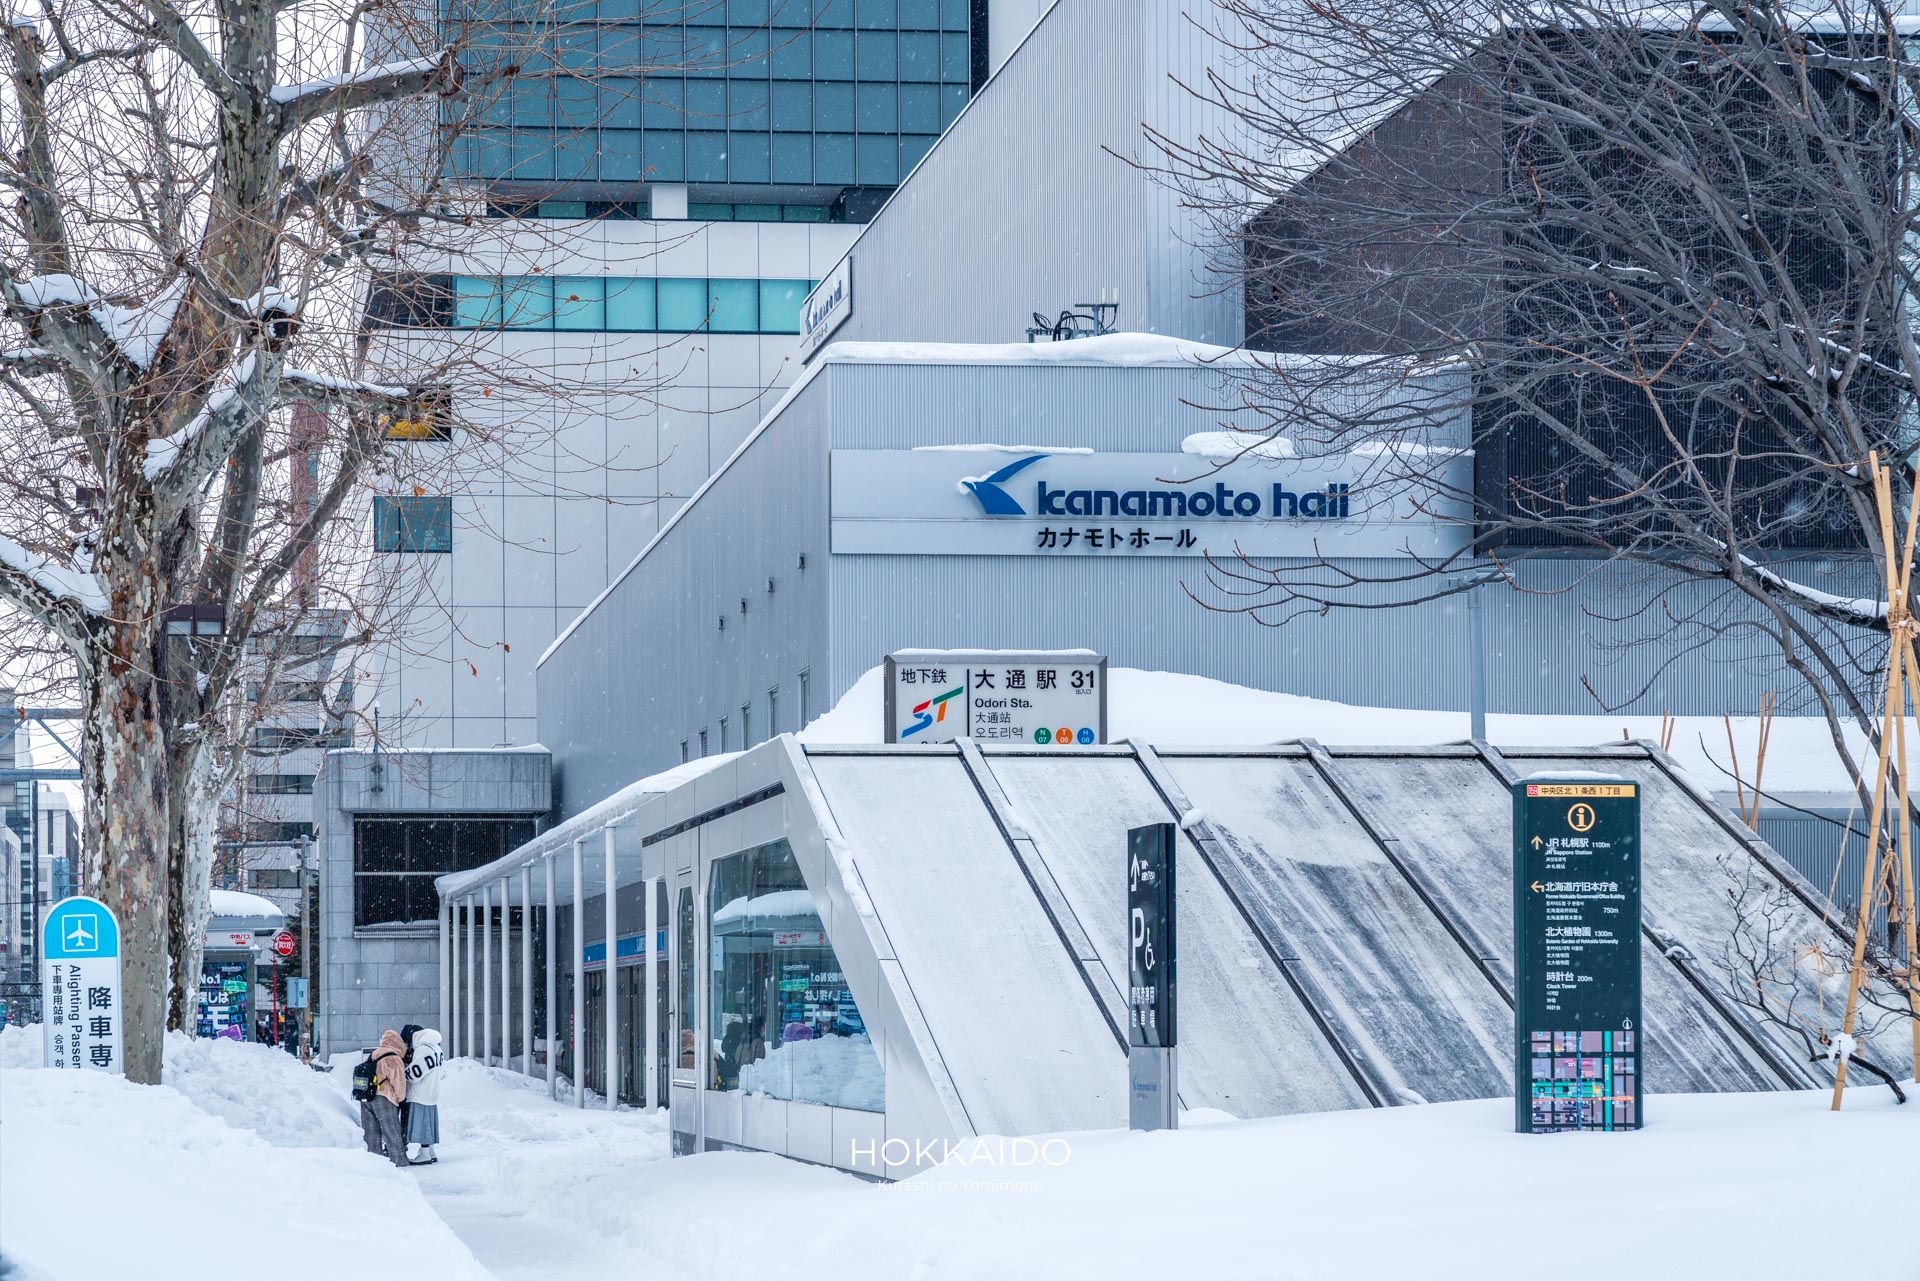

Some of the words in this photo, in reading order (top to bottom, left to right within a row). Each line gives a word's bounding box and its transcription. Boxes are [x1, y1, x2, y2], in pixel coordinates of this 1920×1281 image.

[1037, 481, 1261, 517] kanamoto
[1272, 482, 1349, 518] hall
[1037, 527, 1198, 549] カナモトホール
[901, 668, 947, 684] 地下鉄
[974, 669, 1057, 690] 大通駅
[1070, 670, 1095, 688] 31
[975, 698, 1007, 708] Odori
[1010, 698, 1033, 708] Sta.
[975, 712, 1011, 724] 大通站
[975, 727, 1024, 739] 오도리역
[1038, 736, 1047, 744] 07
[1131, 908, 1145, 972] P
[199, 974, 221, 984] No.1
[1546, 972, 1574, 982] 時計台
[67, 964, 82, 1021] Alighting
